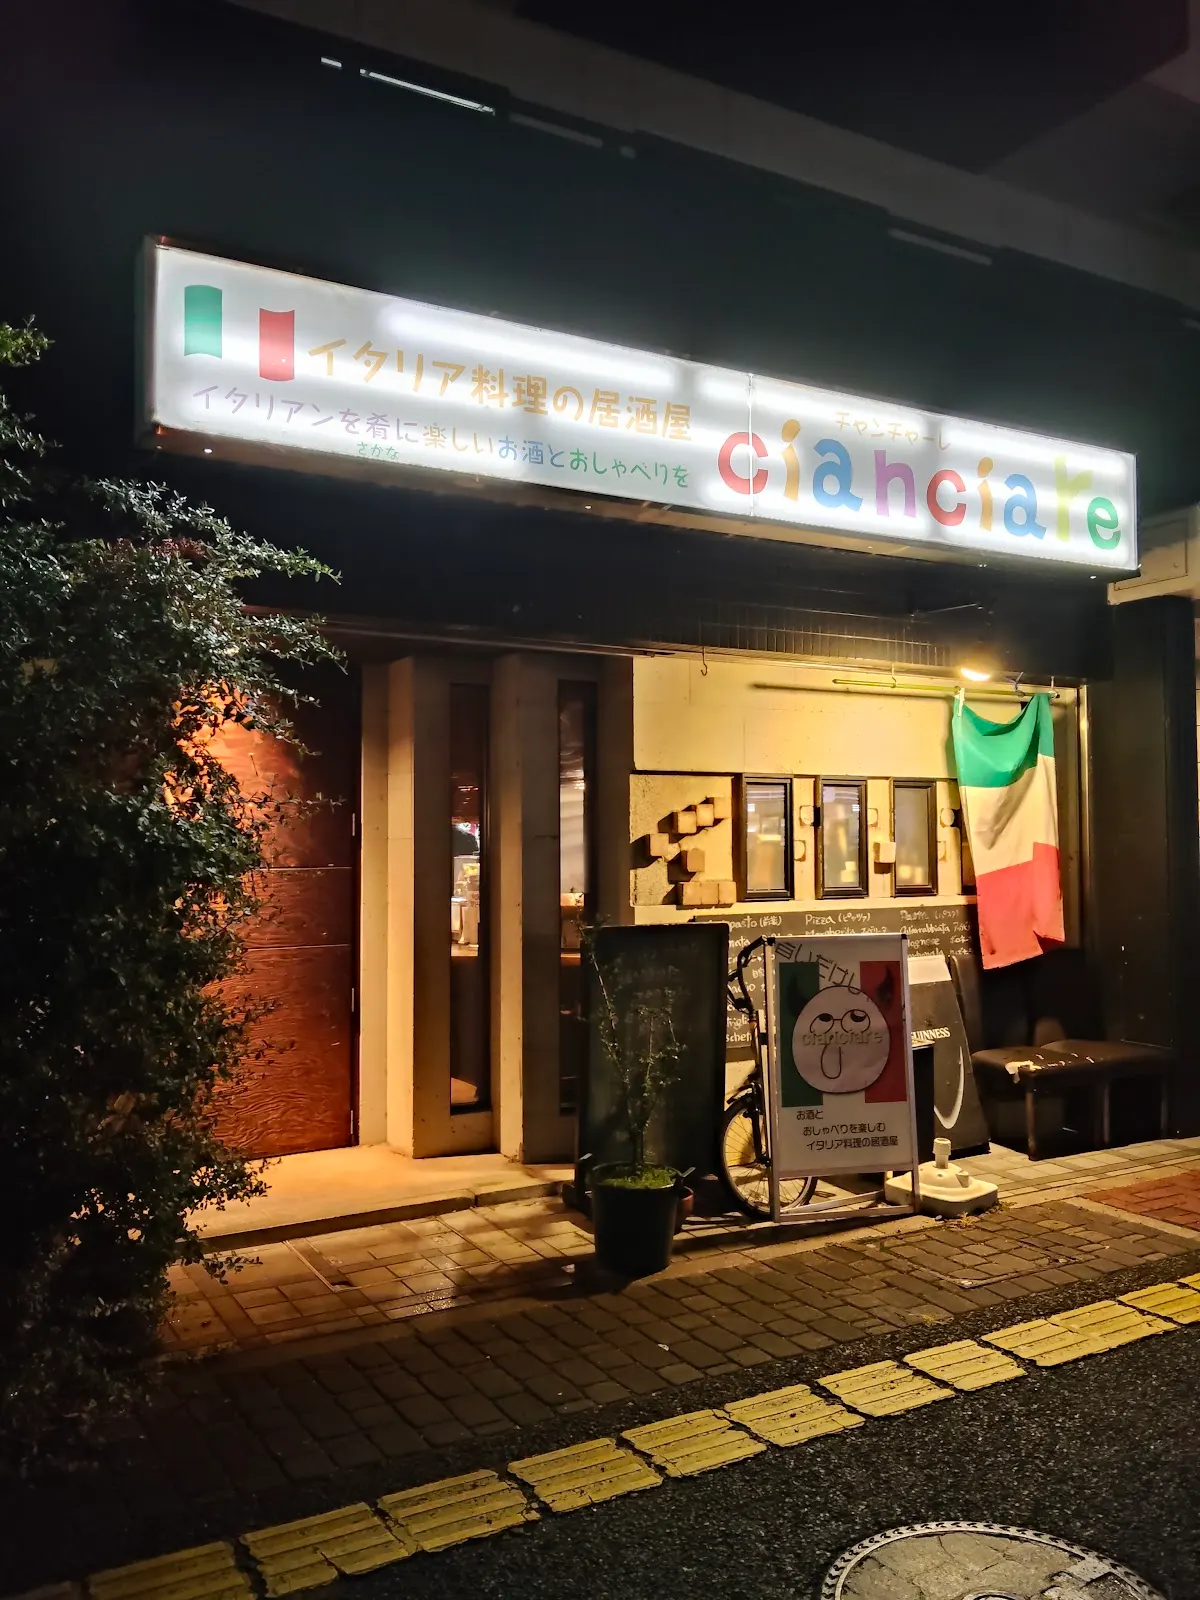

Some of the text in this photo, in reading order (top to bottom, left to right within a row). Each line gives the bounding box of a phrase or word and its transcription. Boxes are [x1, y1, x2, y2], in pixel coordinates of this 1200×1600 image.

[308, 338, 692, 441] イタリア料理の居酒屋
[192, 384, 690, 488] イタリアンを肴に楽しいお酒とおしゃべりを
[356, 441, 399, 461] さかな
[717, 418, 1122, 550] cianciare
[805, 913, 837, 926] Pizza
[796, 1109, 825, 1121] お酒と
[803, 1122, 886, 1137] おしゃべりを楽しむ
[806, 1135, 899, 1151] イタリア料理の居酒屋
